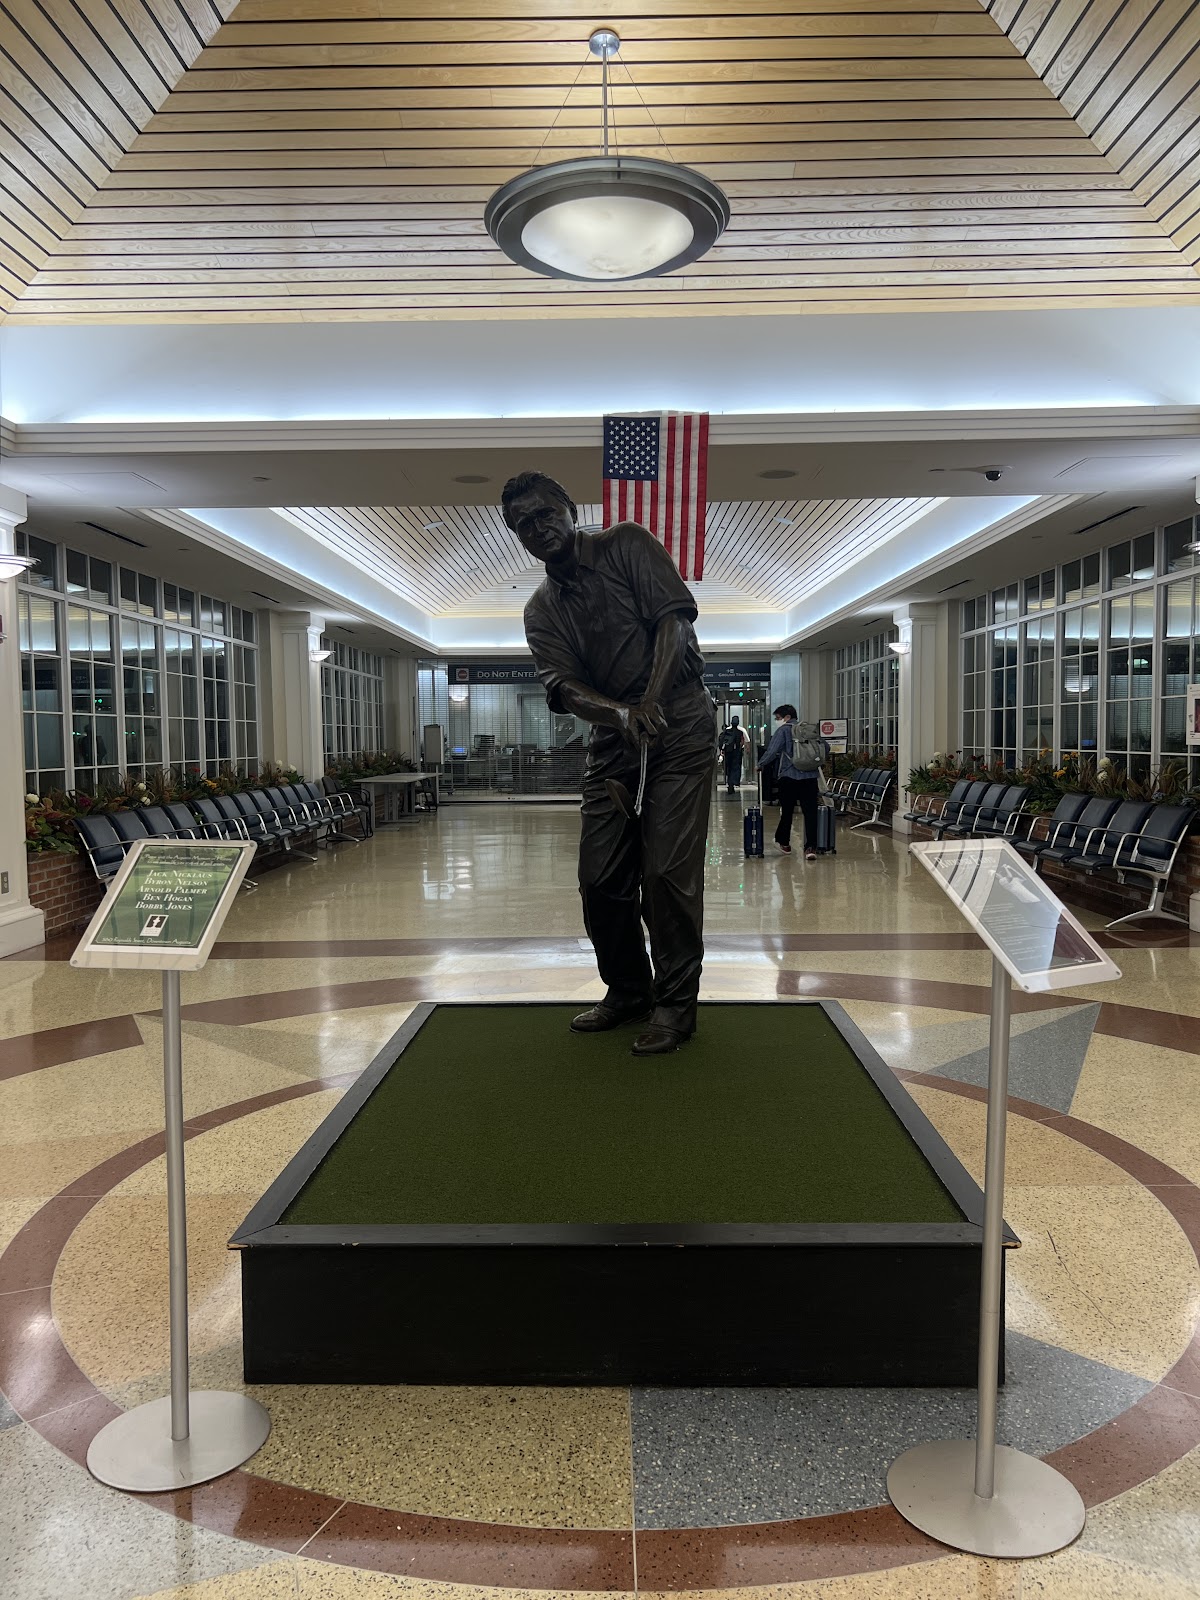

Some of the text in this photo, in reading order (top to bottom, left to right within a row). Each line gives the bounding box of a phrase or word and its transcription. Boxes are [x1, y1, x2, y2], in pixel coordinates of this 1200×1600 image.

[492, 670, 510, 678] NOT
[147, 869, 213, 878] JACK NICKLAUS
[144, 877, 209, 886] BYRON NELSON
[136, 885, 208, 894] ARNOLD PALMER
[142, 893, 194, 902] BEN HOGAN
[135, 901, 193, 910] BOBBY JONES
